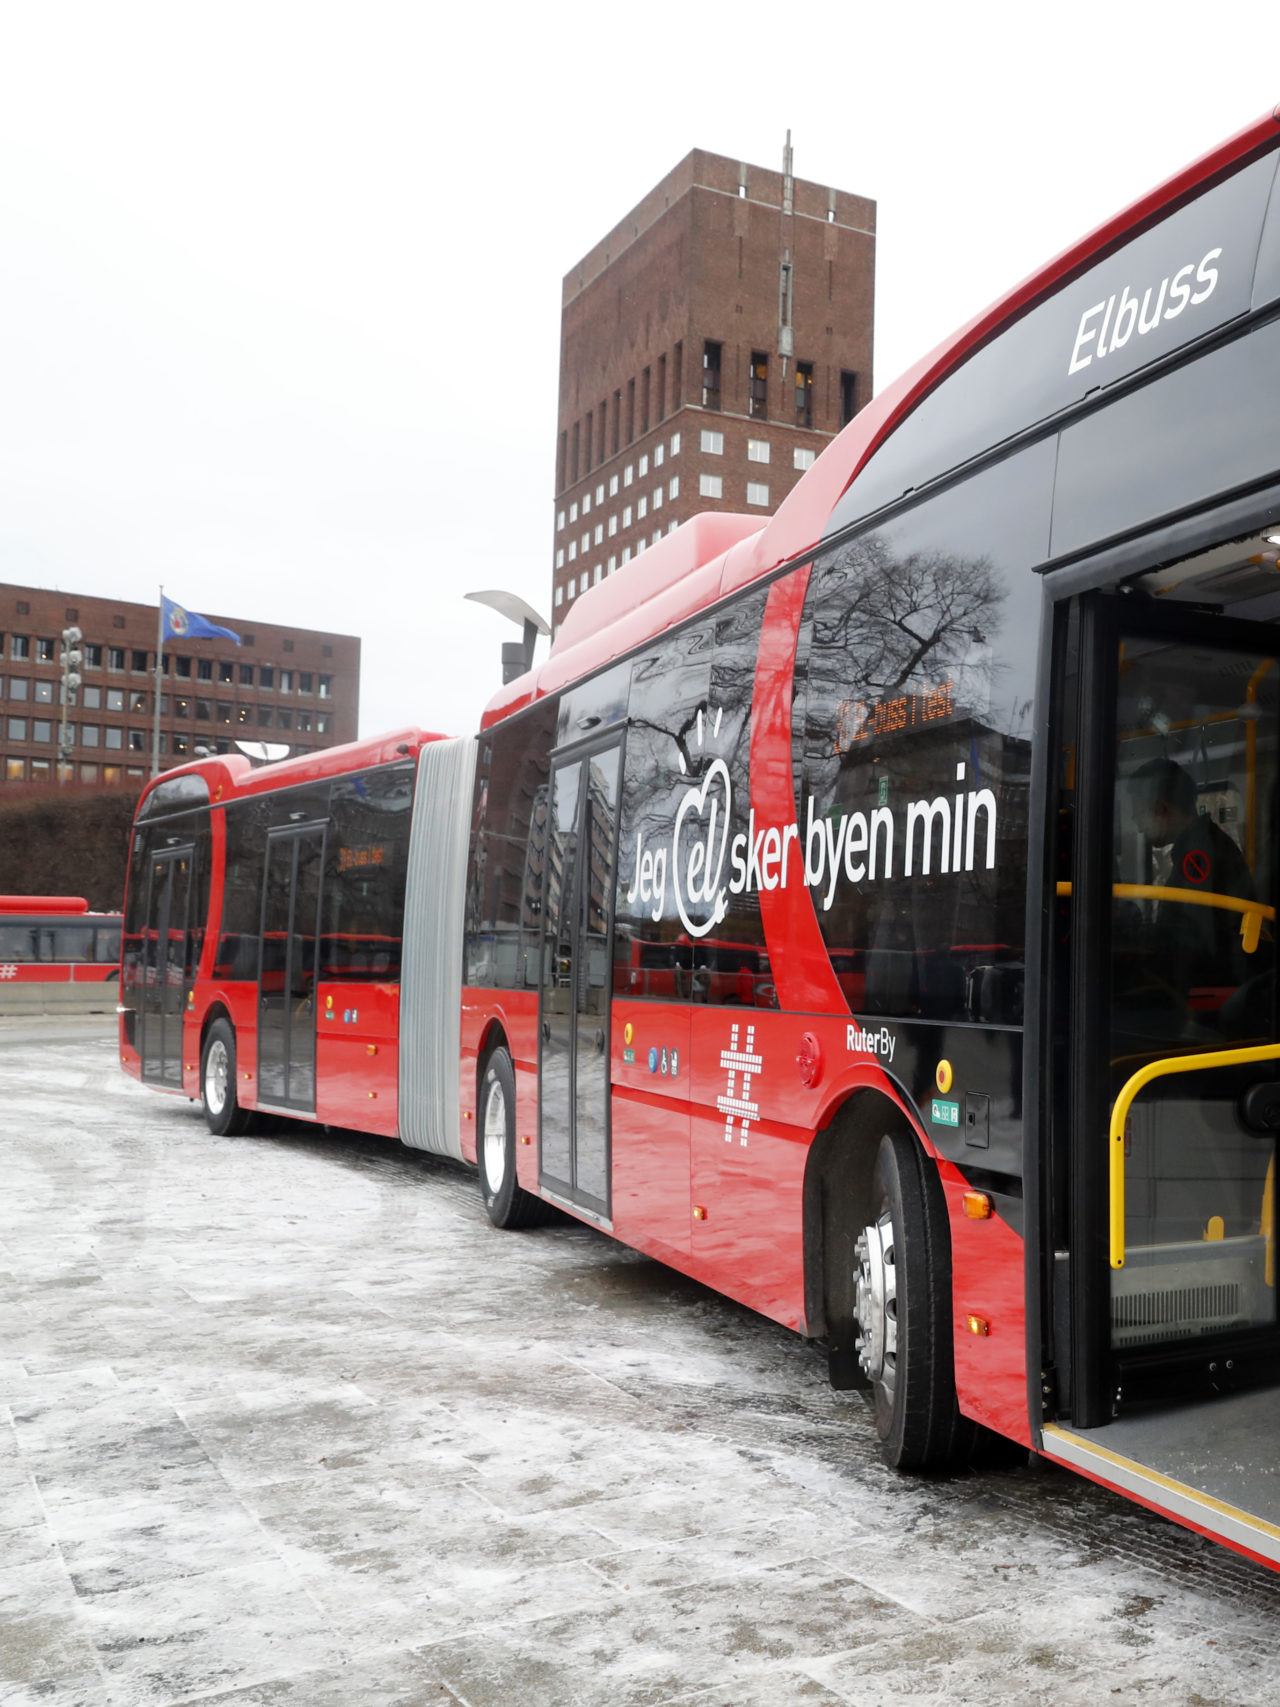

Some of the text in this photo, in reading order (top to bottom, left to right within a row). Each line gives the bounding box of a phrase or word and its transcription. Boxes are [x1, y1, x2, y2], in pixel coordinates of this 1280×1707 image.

[1068, 247, 1223, 376] Elbuss
[627, 833, 667, 922] Jeg
[803, 795, 894, 911] byen
[904, 761, 997, 877] min
[846, 1024, 896, 1063] RuterBy
